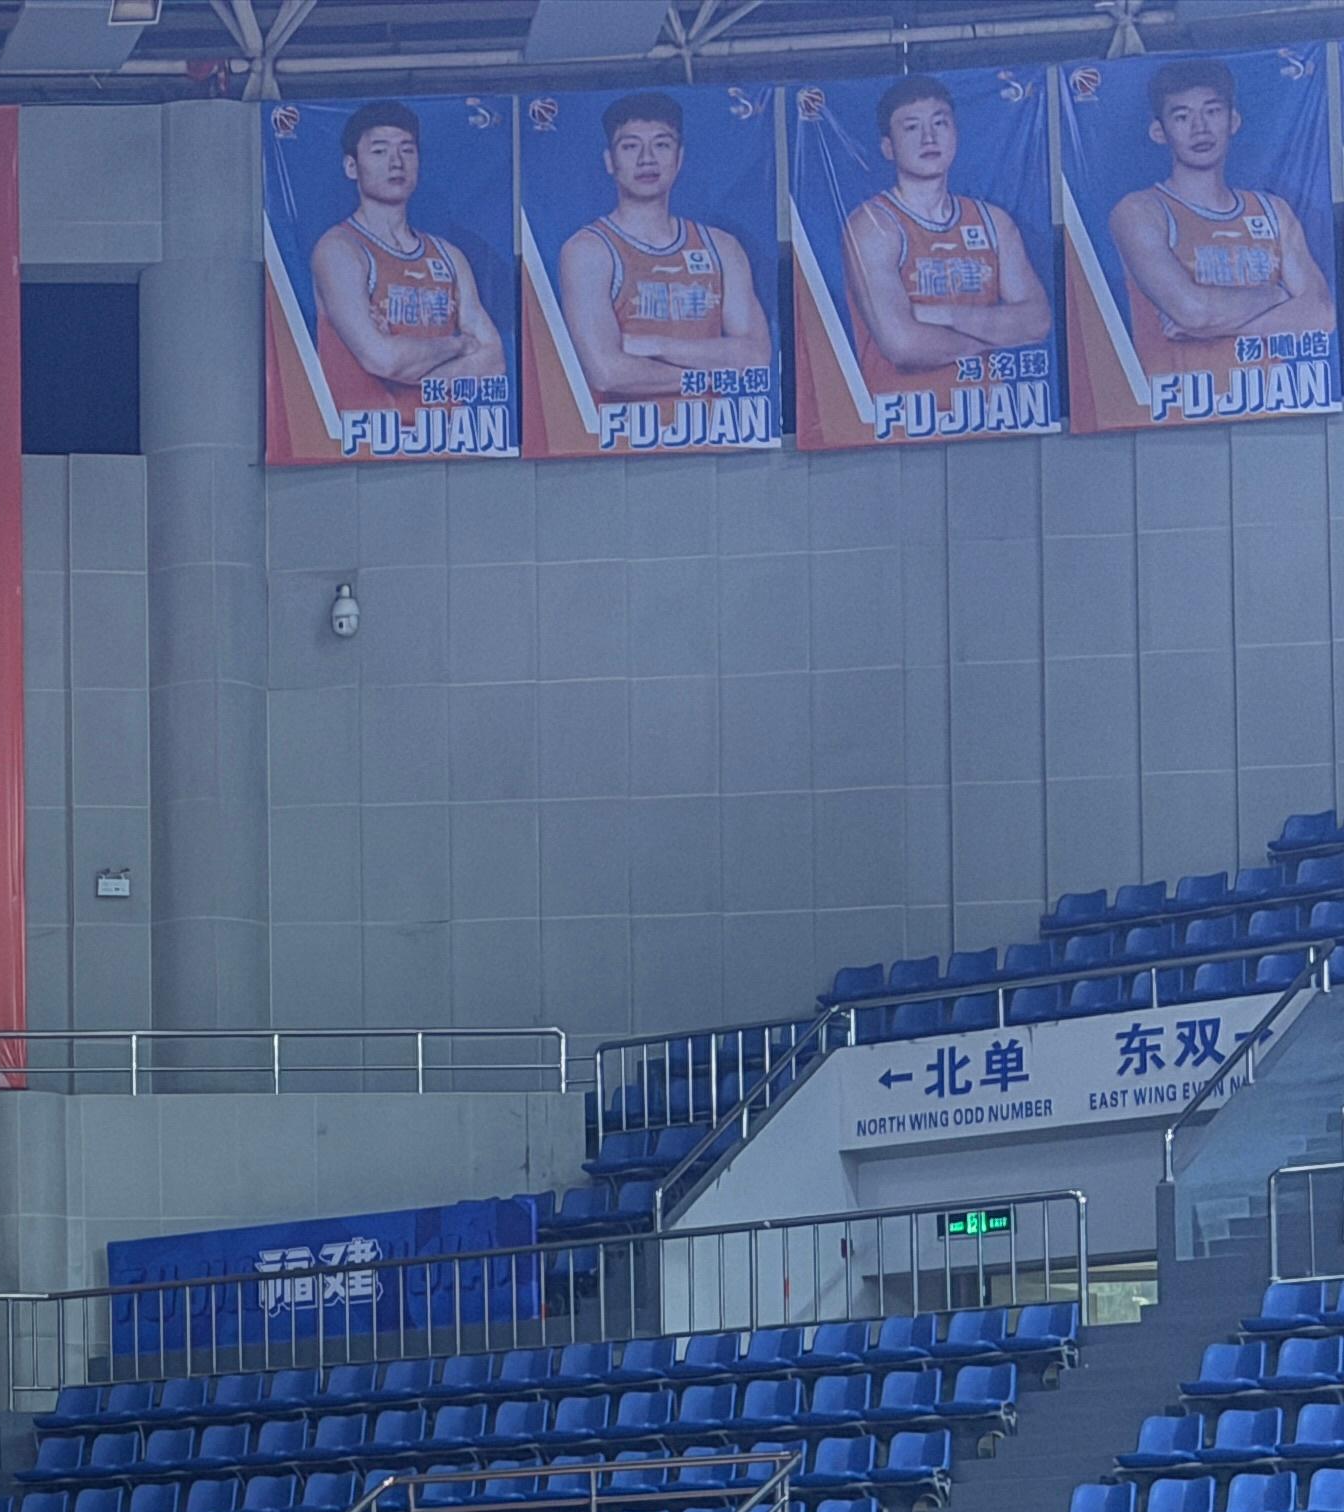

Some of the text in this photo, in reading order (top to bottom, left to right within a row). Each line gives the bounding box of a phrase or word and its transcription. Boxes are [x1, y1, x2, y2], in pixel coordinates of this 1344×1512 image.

[874, 380, 1051, 442] FUJIAN
[1151, 360, 1331, 423] FUJIAN
[341, 406, 511, 458] FUJIAN
[599, 397, 772, 450] FUJIAN
[924, 1038, 1030, 1099] 北单
[1115, 1016, 1226, 1077] 东双
[856, 1098, 1054, 1137] NORTH WING ODD NUMBER
[1089, 1090, 1129, 1111] EAST
[1134, 1086, 1178, 1108] WING
[1182, 1079, 1225, 1103] EVN
